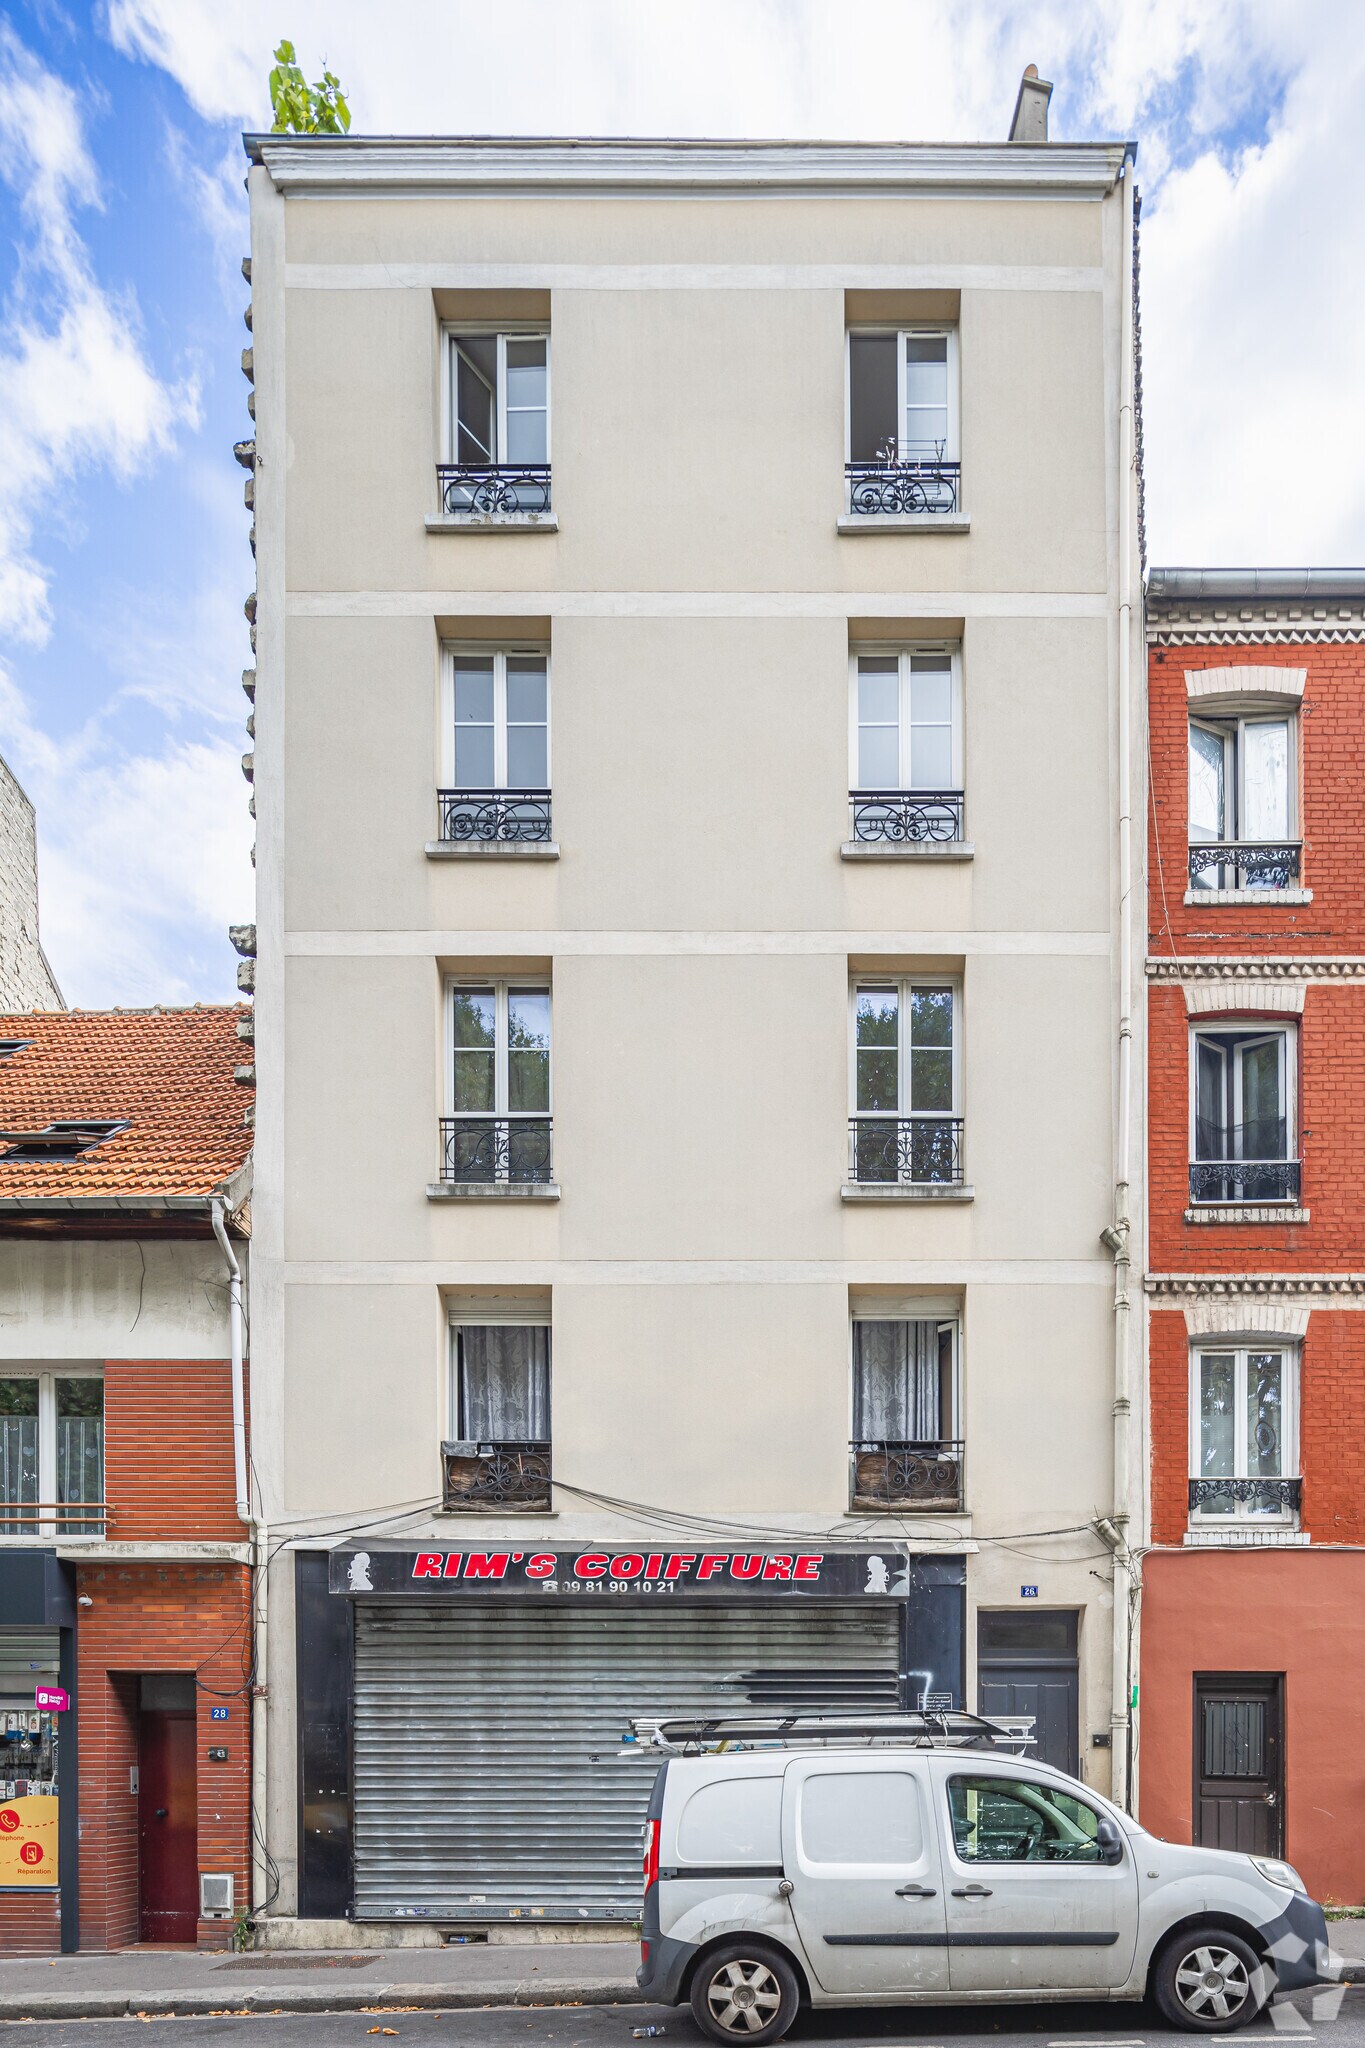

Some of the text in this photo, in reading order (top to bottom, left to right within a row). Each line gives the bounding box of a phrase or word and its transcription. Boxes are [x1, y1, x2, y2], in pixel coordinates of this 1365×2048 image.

[412, 1552, 823, 1581] RIM'S COIFFURE
[562, 1581, 674, 1593] 09 81 90 10 21
[1024, 1587, 1035, 1596] 26
[213, 1709, 226, 1718] 28
